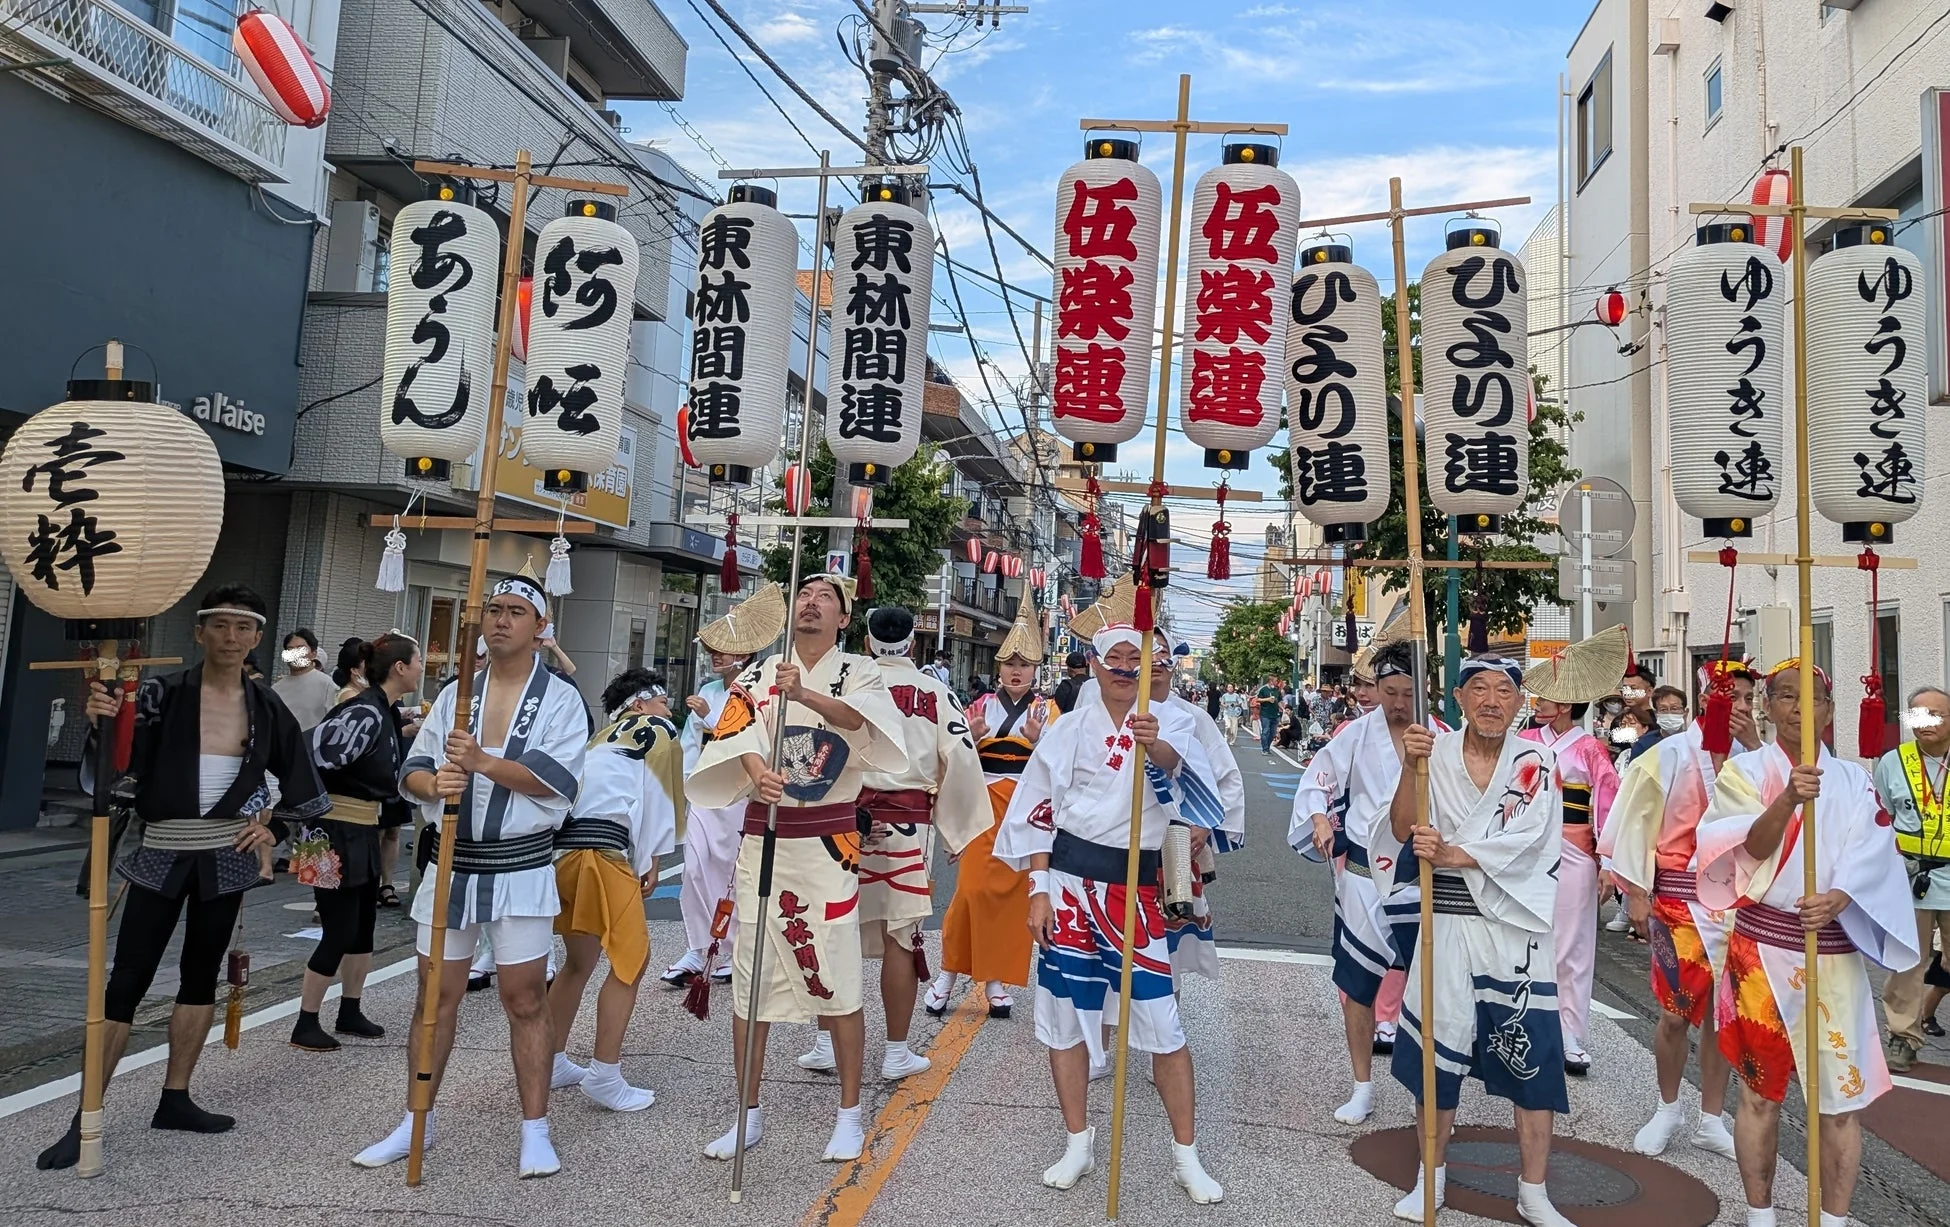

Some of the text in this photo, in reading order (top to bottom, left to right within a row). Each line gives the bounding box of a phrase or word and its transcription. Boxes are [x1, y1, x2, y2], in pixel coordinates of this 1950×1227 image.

[391, 209, 473, 430] あうん
[687, 214, 755, 440] 東林間連
[838, 214, 914, 442] 東林間連
[1054, 177, 1138, 424] 伍楽連
[1188, 182, 1282, 428] 伍楽連
[1290, 270, 1369, 506] ひより連
[1445, 256, 1520, 495] ひより連
[1714, 256, 1775, 501] ゆうき連
[1853, 256, 1917, 504] ゆうき連
[512, 696, 540, 739] あうん
[1335, 624, 1374, 639] おば
